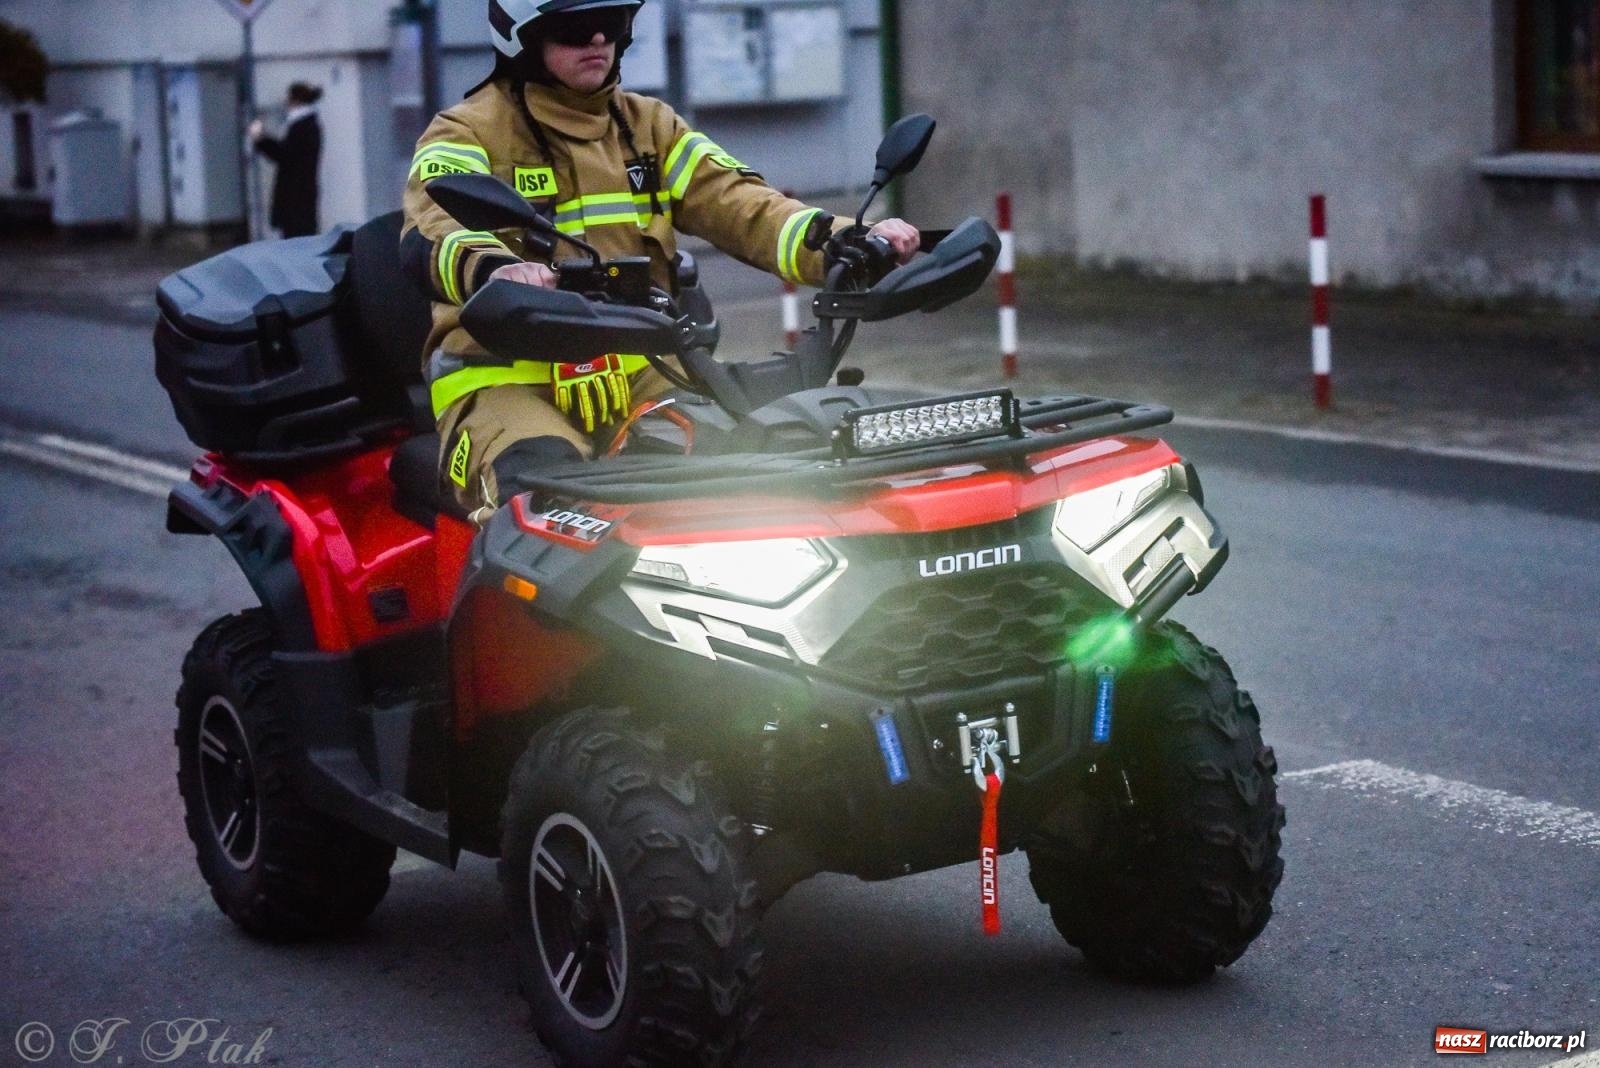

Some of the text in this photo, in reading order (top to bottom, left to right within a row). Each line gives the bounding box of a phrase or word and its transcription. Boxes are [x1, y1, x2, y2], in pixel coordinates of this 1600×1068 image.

[518, 172, 549, 192] OSP
[453, 439, 466, 479] OSP
[919, 543, 1021, 577] LONCIN
[982, 847, 995, 905] LONCIN
